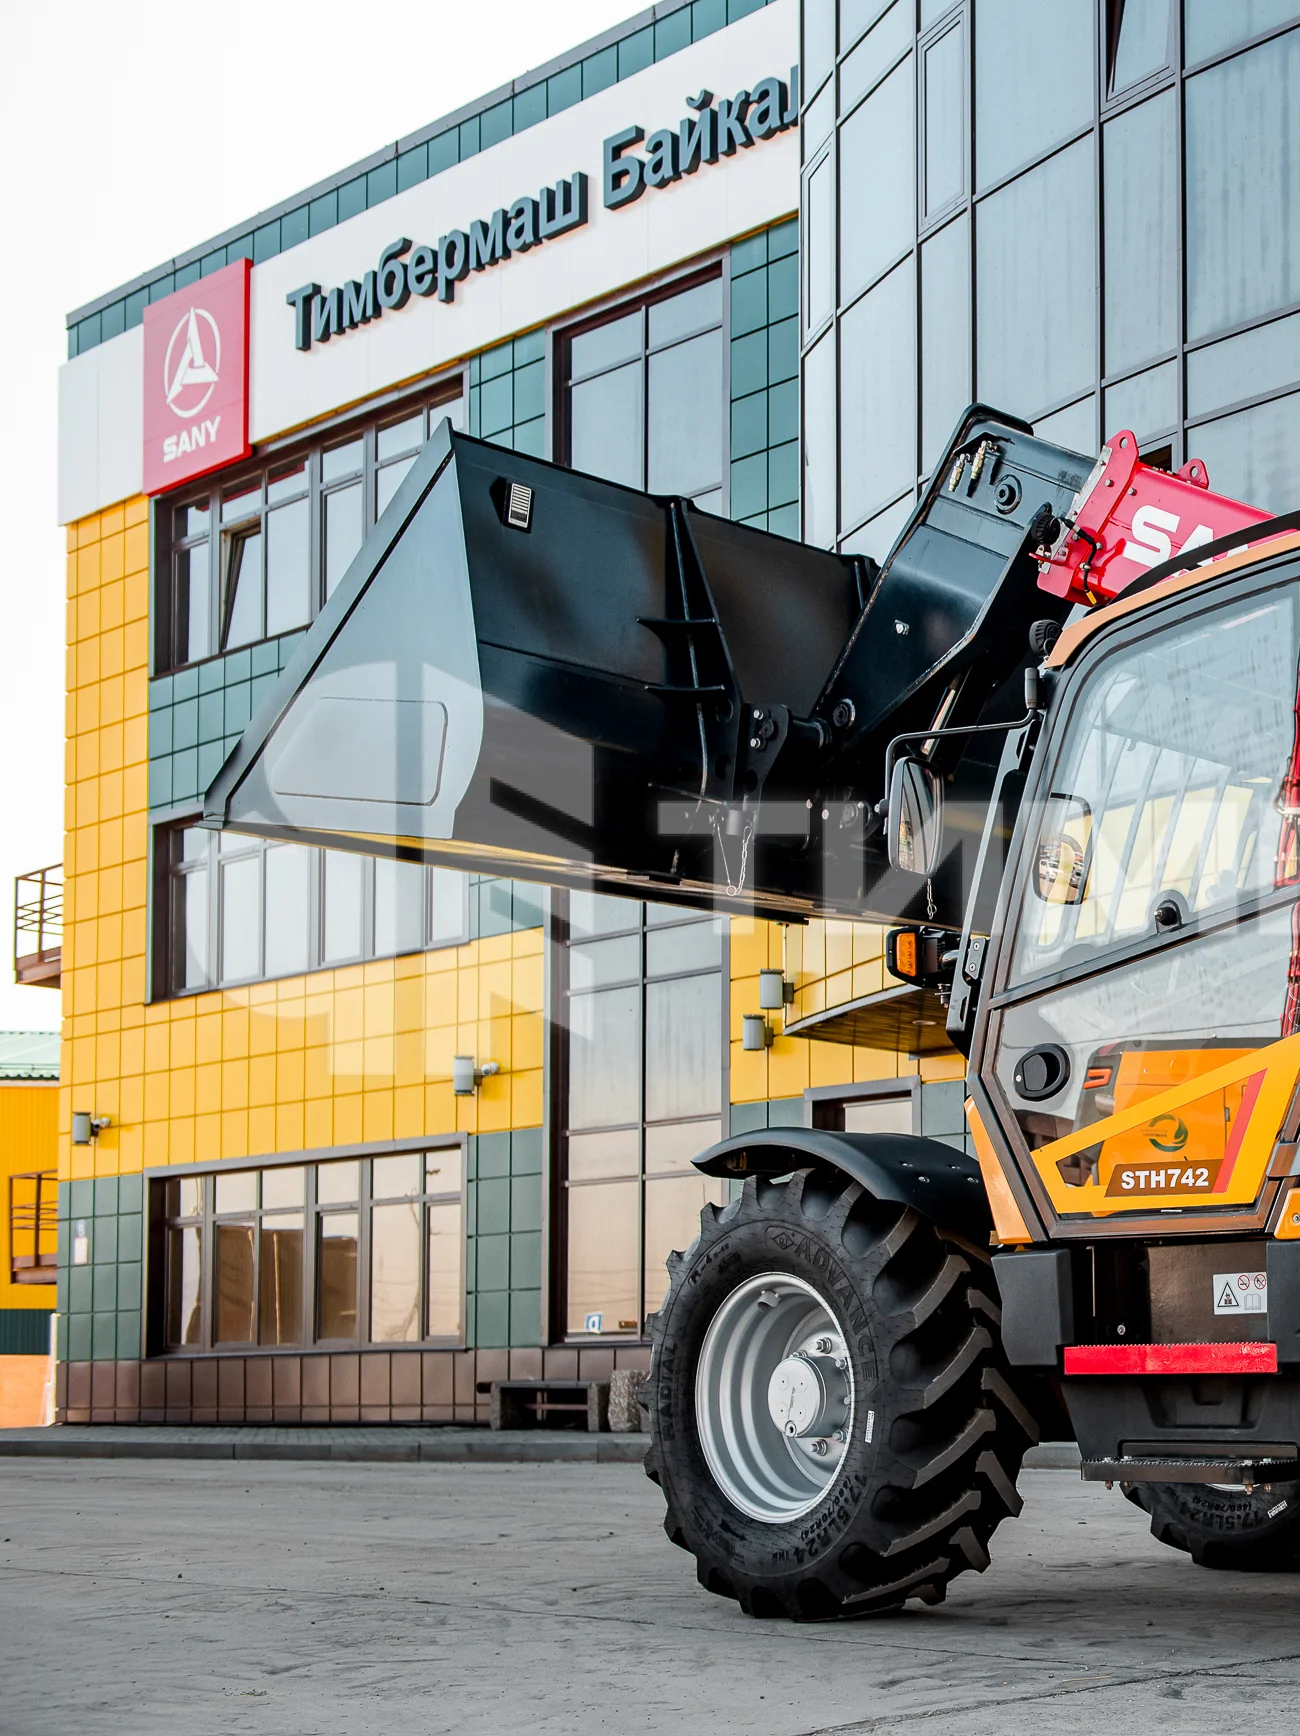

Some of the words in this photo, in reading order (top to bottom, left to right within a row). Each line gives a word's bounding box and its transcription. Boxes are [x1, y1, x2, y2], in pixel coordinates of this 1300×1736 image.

[287, 171, 588, 352] Тимбермаш
[163, 416, 221, 463] SANY
[1122, 505, 1249, 580] SA
[1121, 1168, 1209, 1189] STH742
[794, 1237, 879, 1381] ADVANCE
